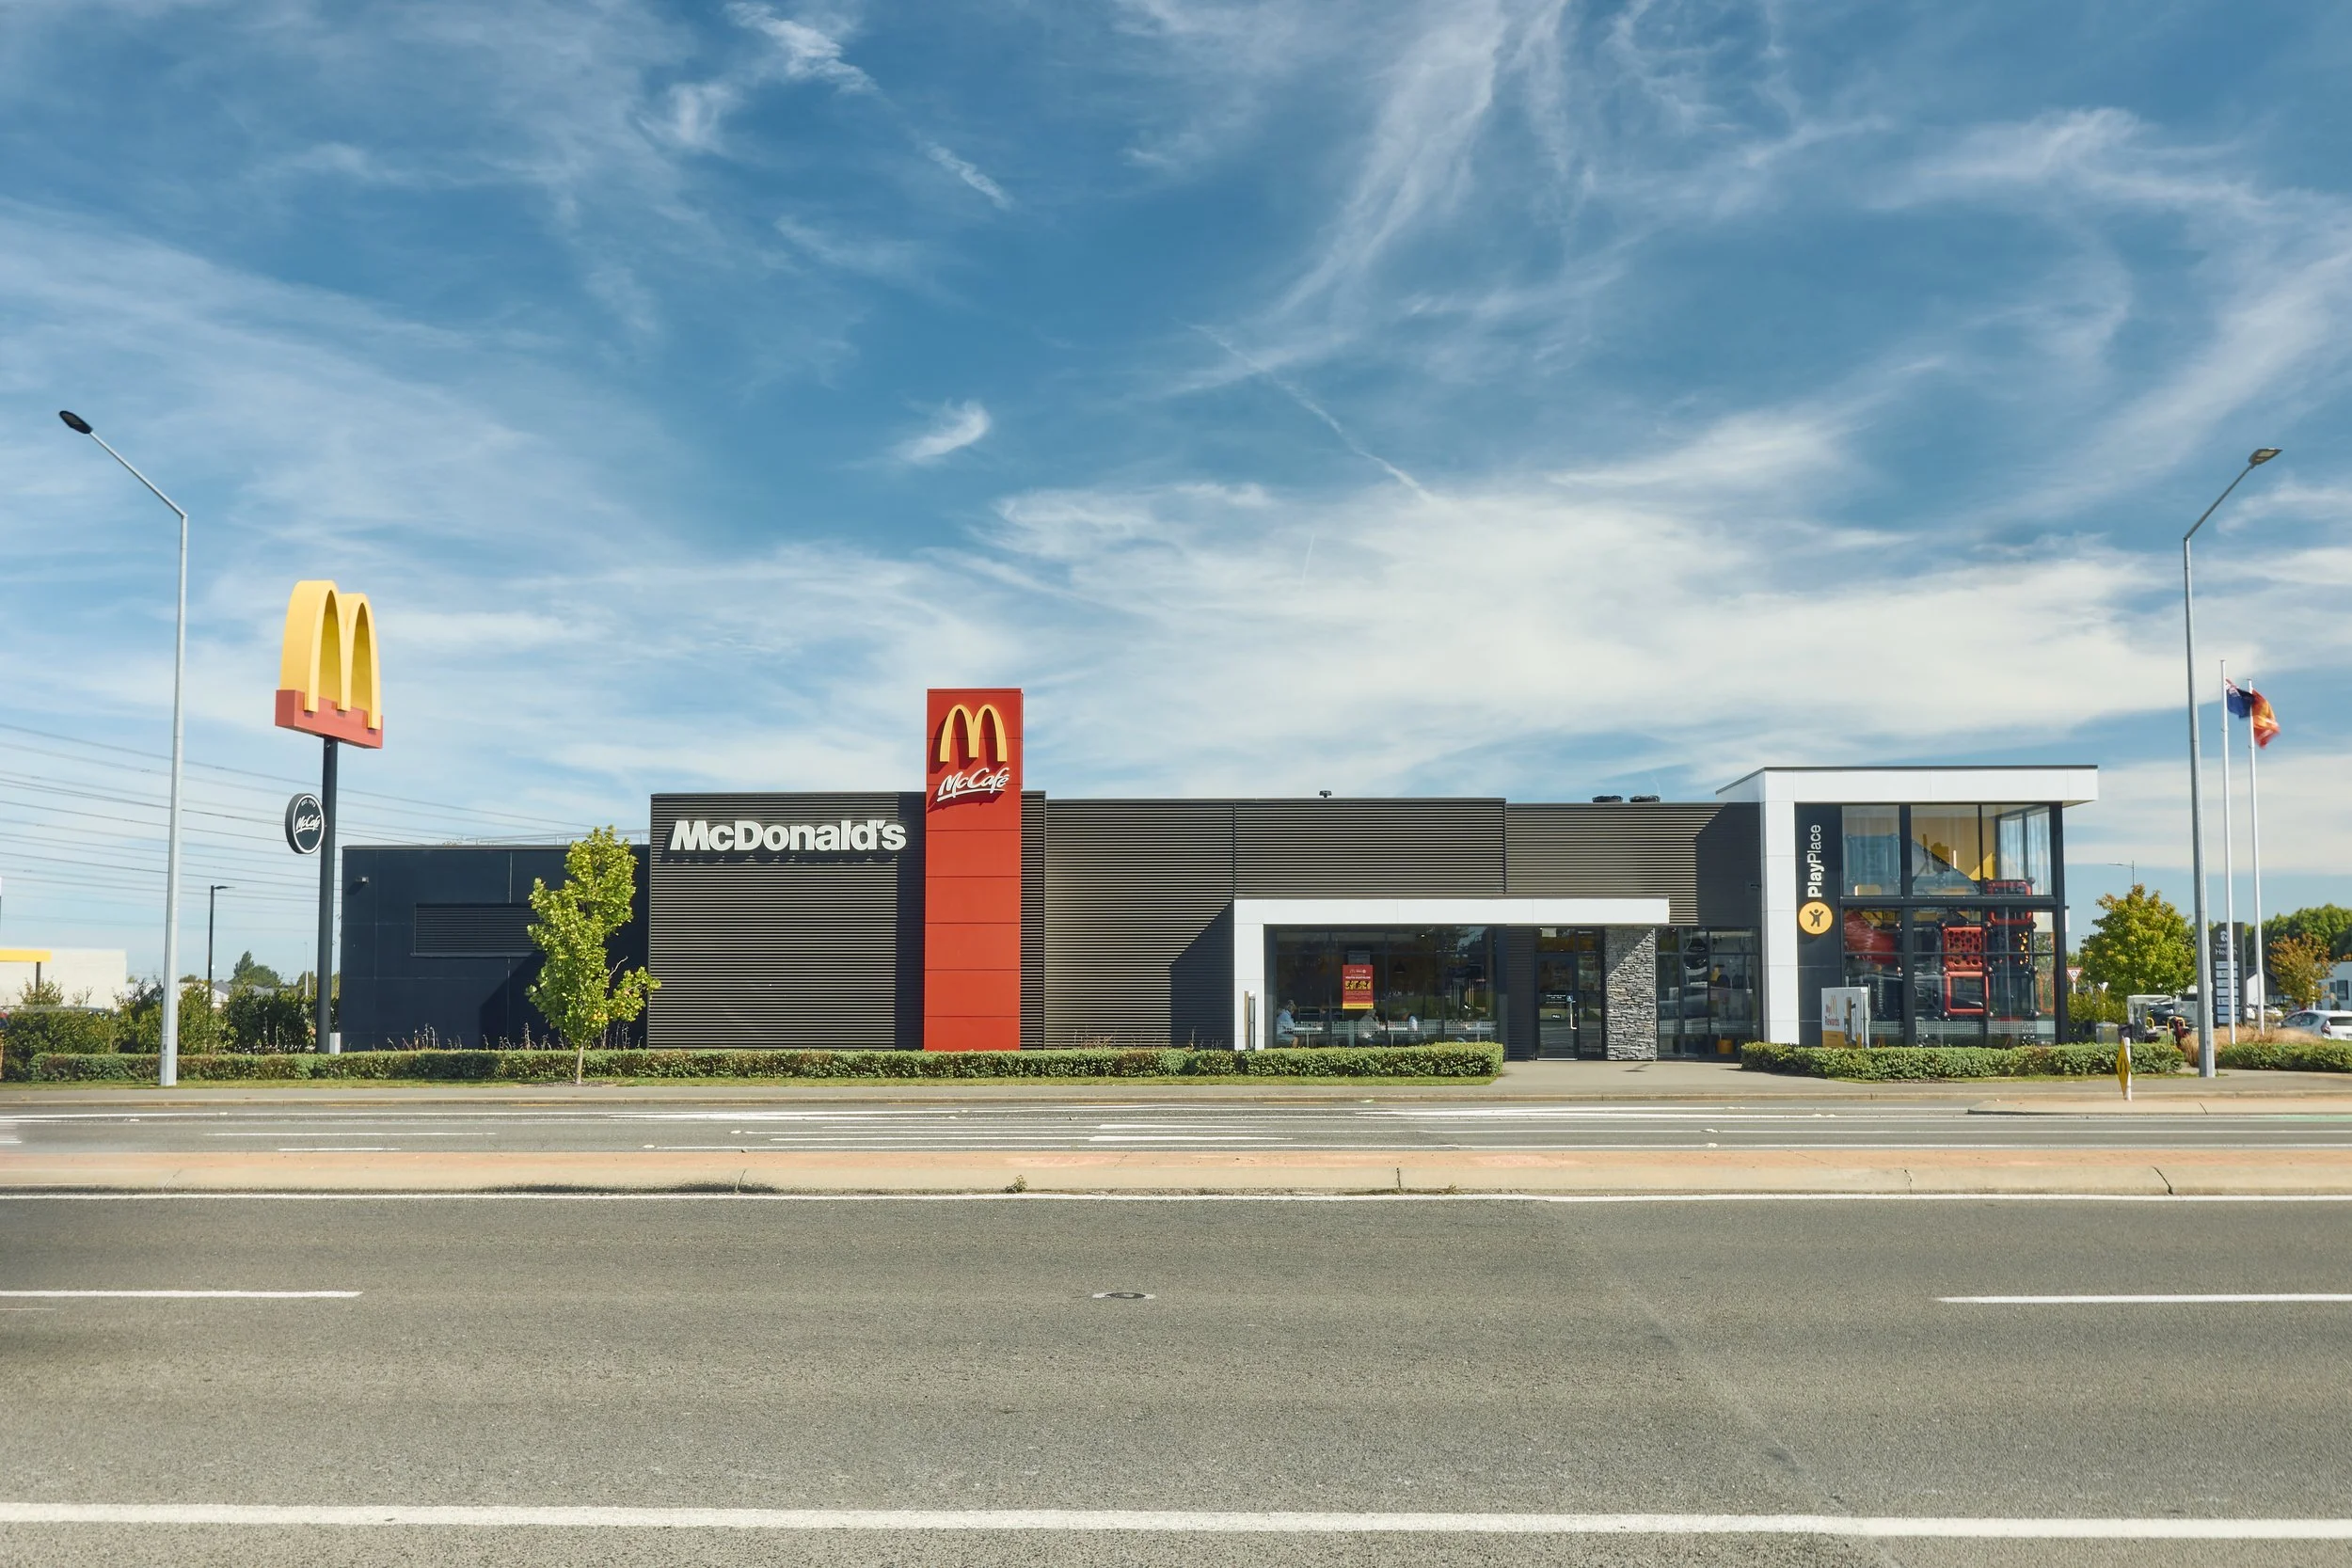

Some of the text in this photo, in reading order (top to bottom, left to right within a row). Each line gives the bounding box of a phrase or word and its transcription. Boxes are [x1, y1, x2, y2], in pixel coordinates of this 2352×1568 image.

[937, 768, 1009, 800] McCafé
[670, 820, 907, 851] McDonald's
[1806, 824, 1824, 898] PlayPlace
